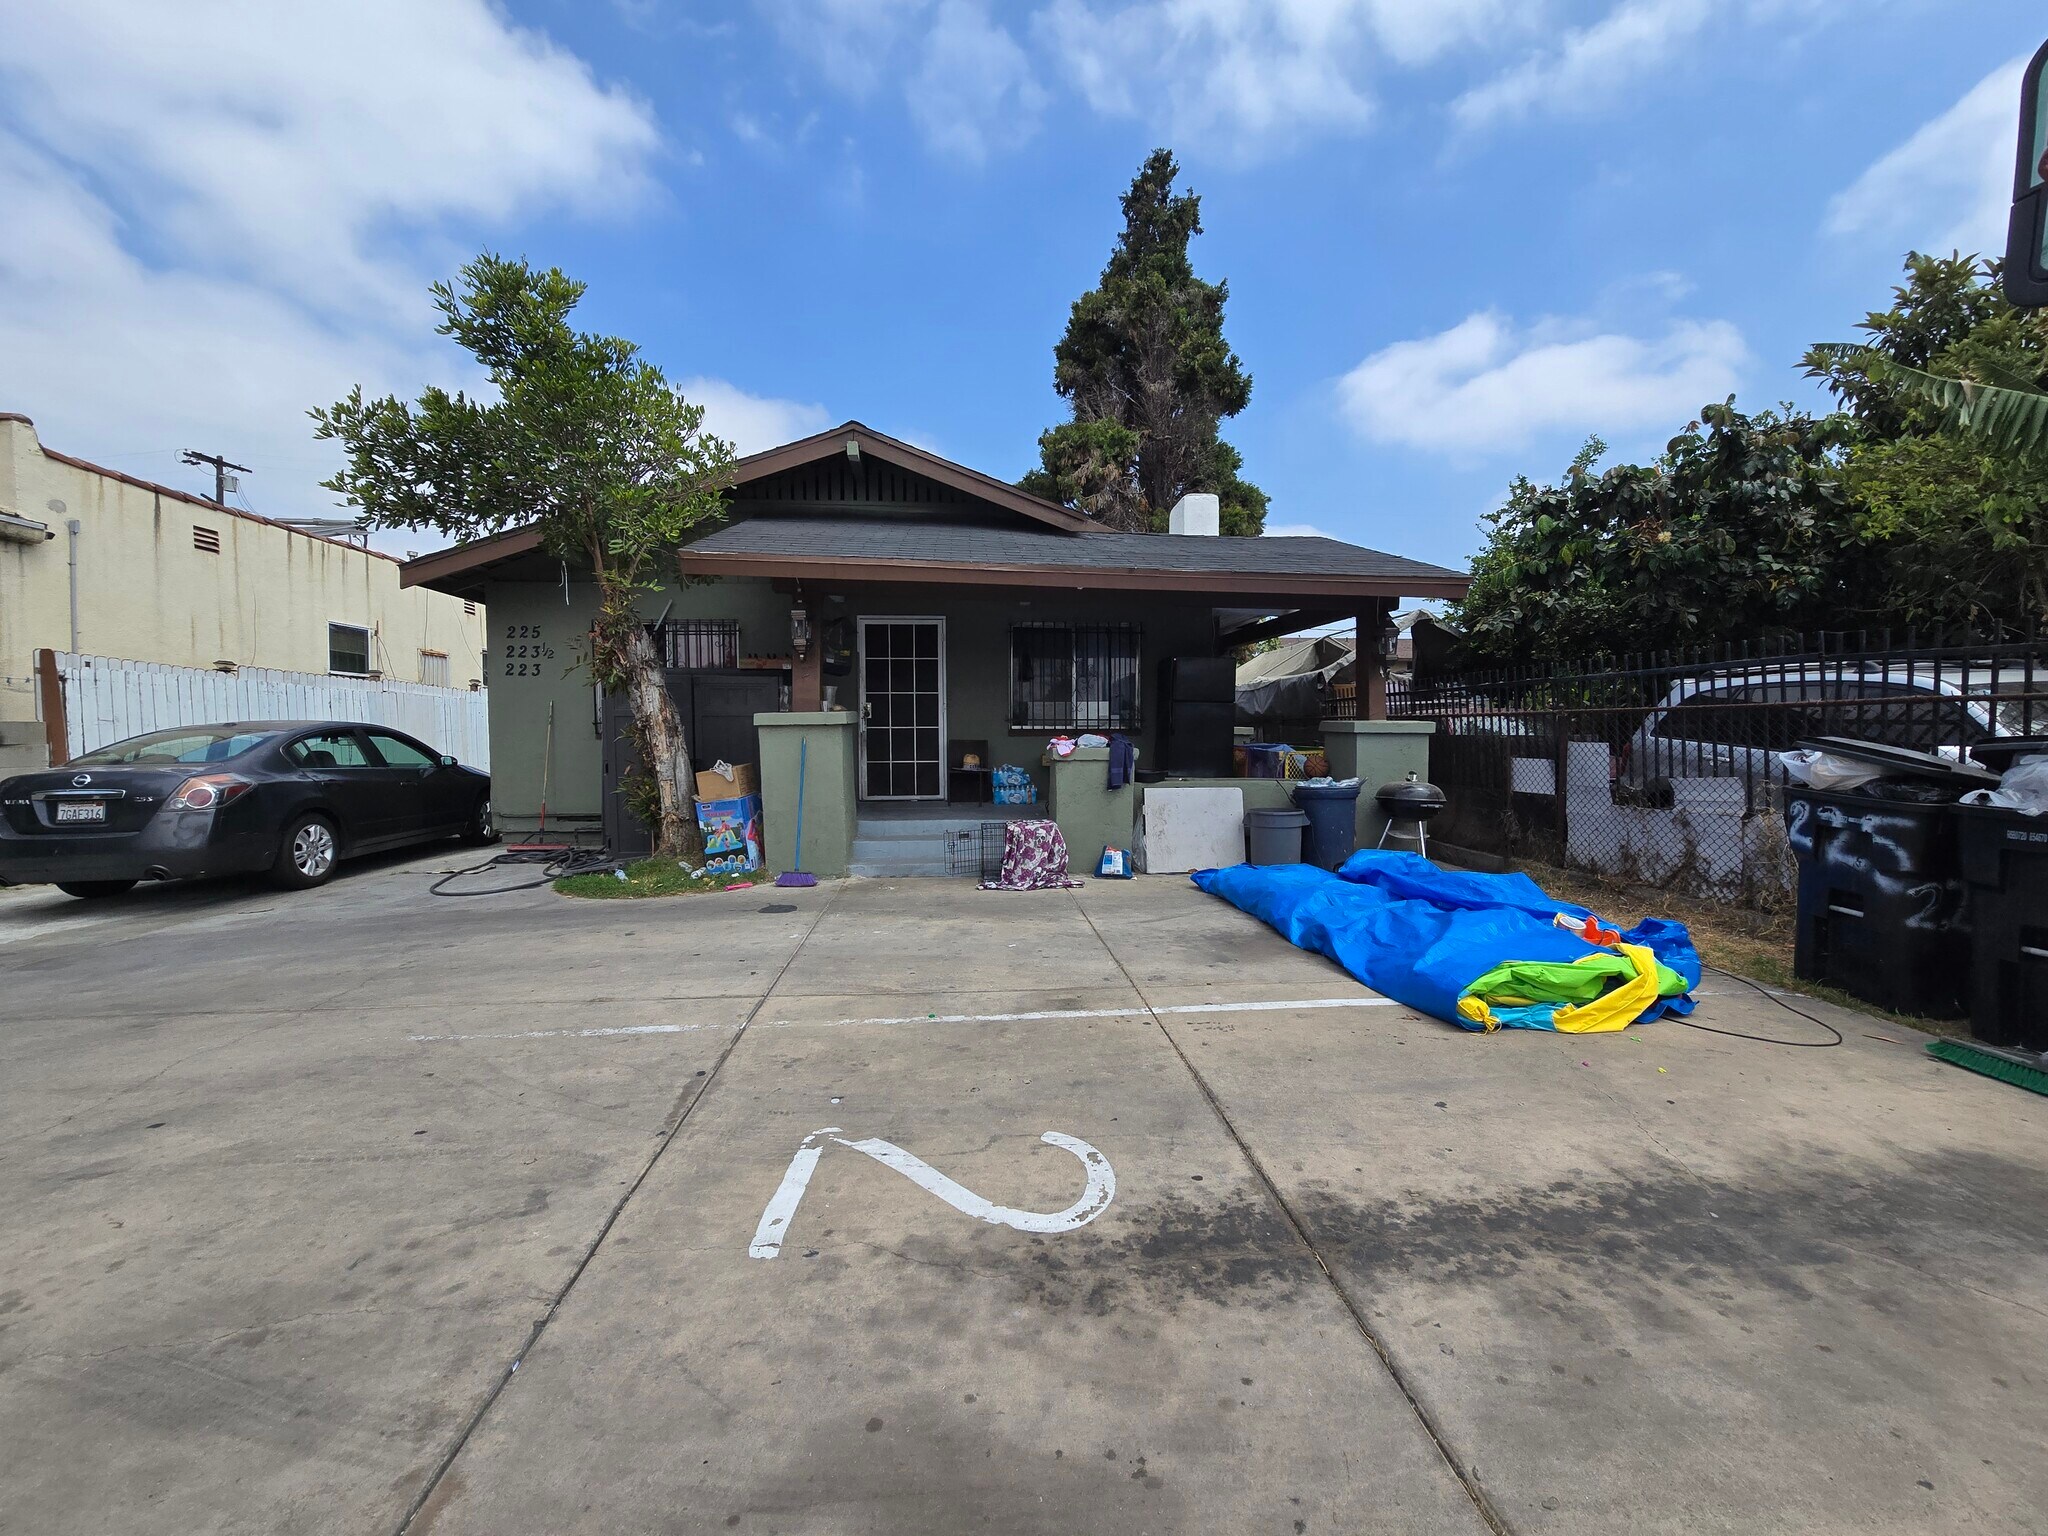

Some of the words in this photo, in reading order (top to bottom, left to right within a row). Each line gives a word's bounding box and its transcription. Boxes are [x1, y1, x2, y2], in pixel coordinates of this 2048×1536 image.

[506, 625, 541, 639] 225
[505, 663, 541, 677] 223
[60, 808, 102, 820] 7GAF316
[748, 1127, 1116, 1259] 2
